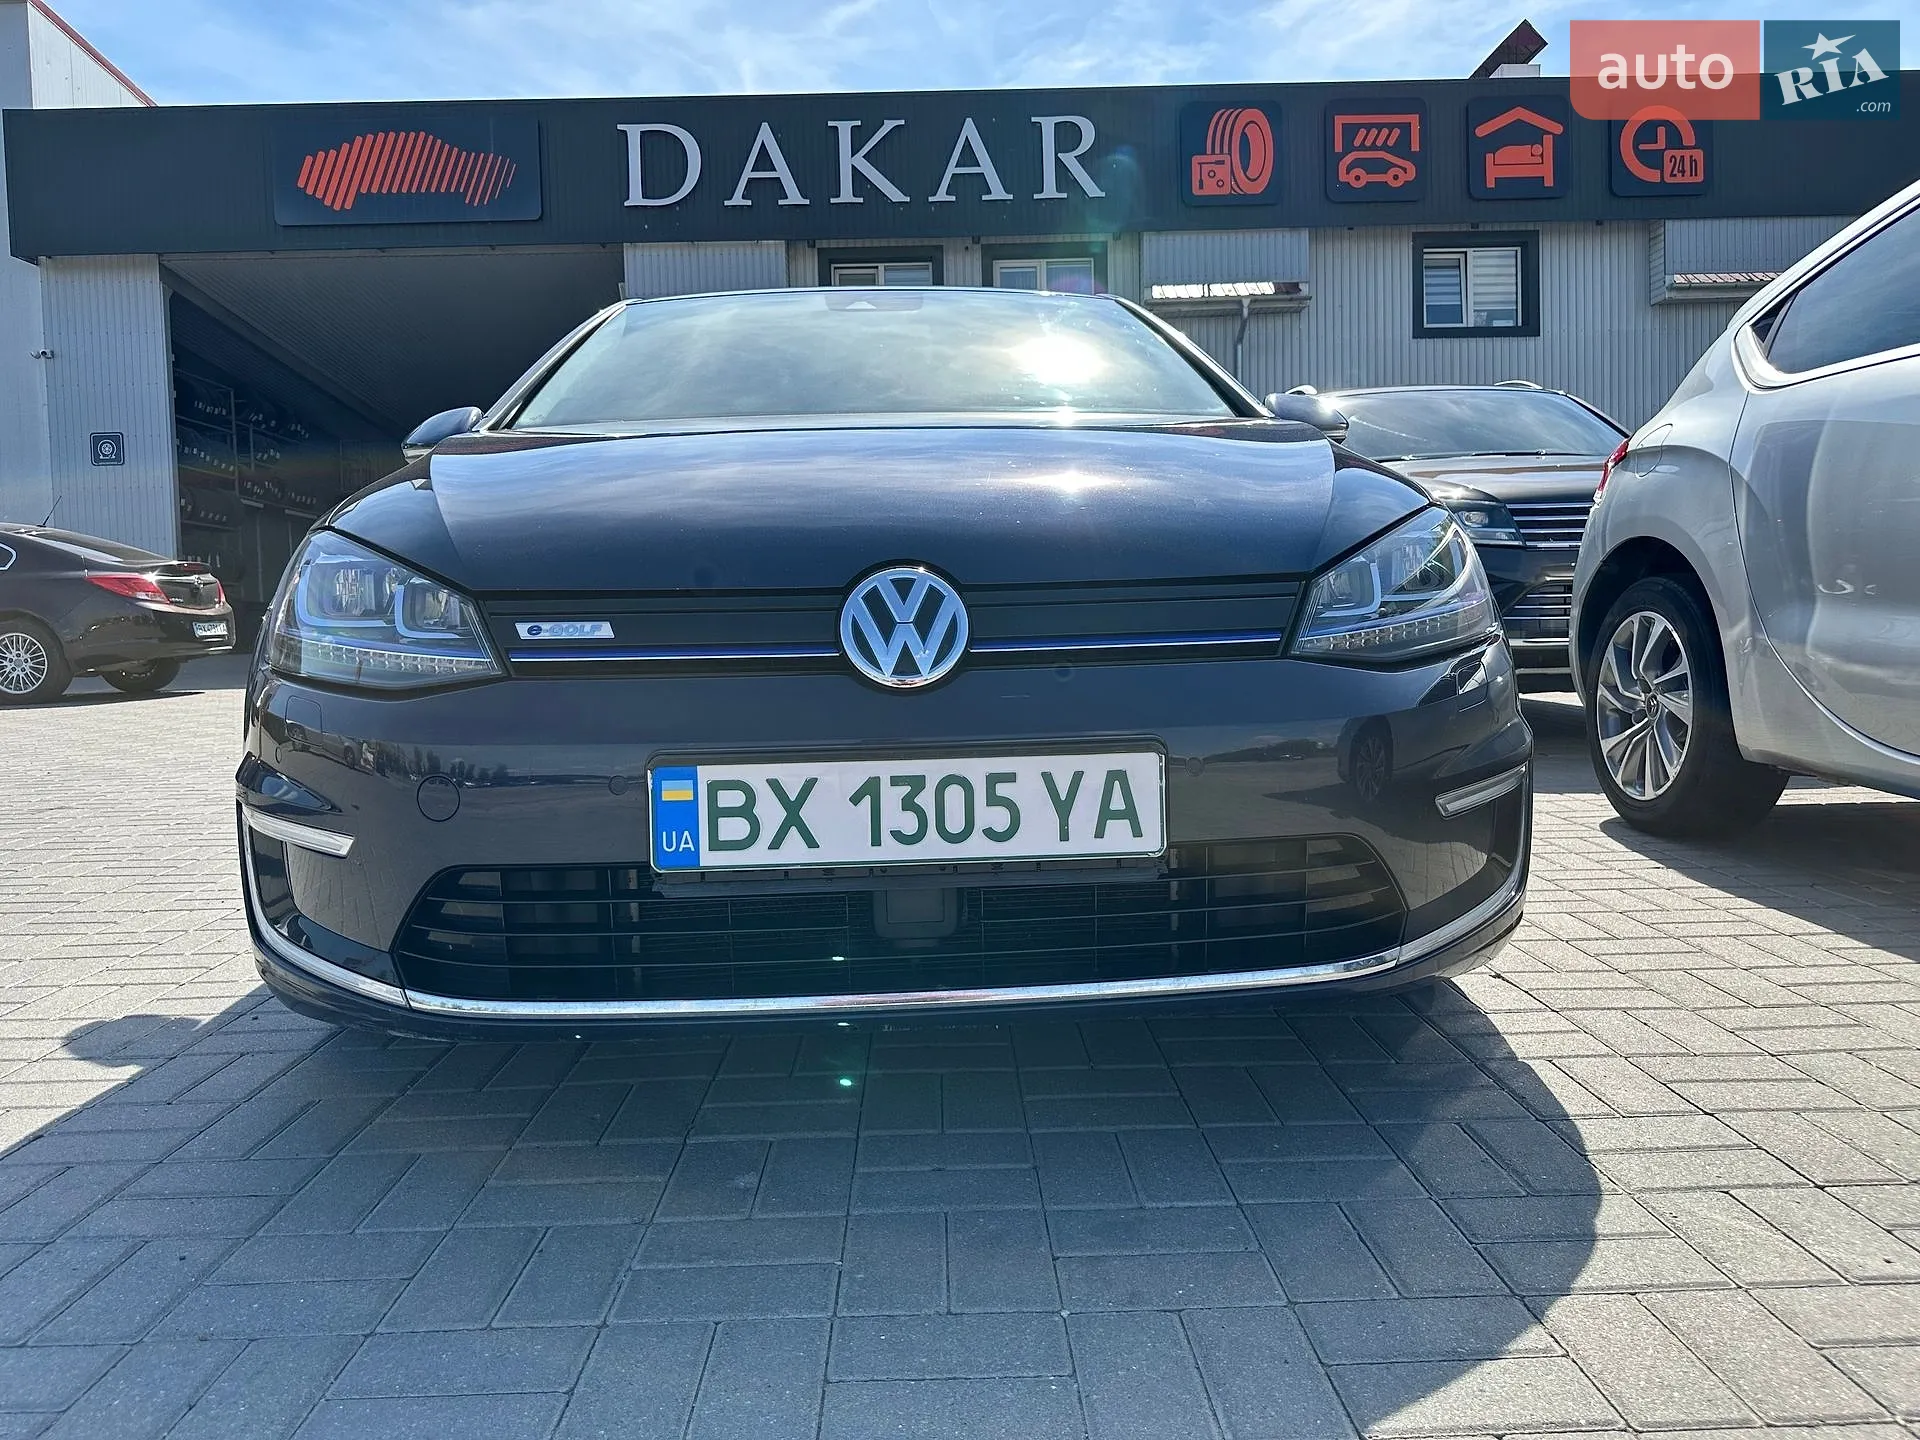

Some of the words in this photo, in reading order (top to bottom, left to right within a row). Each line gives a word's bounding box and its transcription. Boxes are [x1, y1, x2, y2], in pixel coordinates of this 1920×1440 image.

[616, 115, 1106, 207] DAKAR
[1669, 154, 1686, 178] 24
[1688, 154, 1699, 177] h
[526, 624, 603, 636] e-GOLF
[706, 777, 820, 852] BX
[848, 772, 1021, 847] 1305
[1040, 769, 1144, 843] YA
[662, 831, 695, 852] UA
